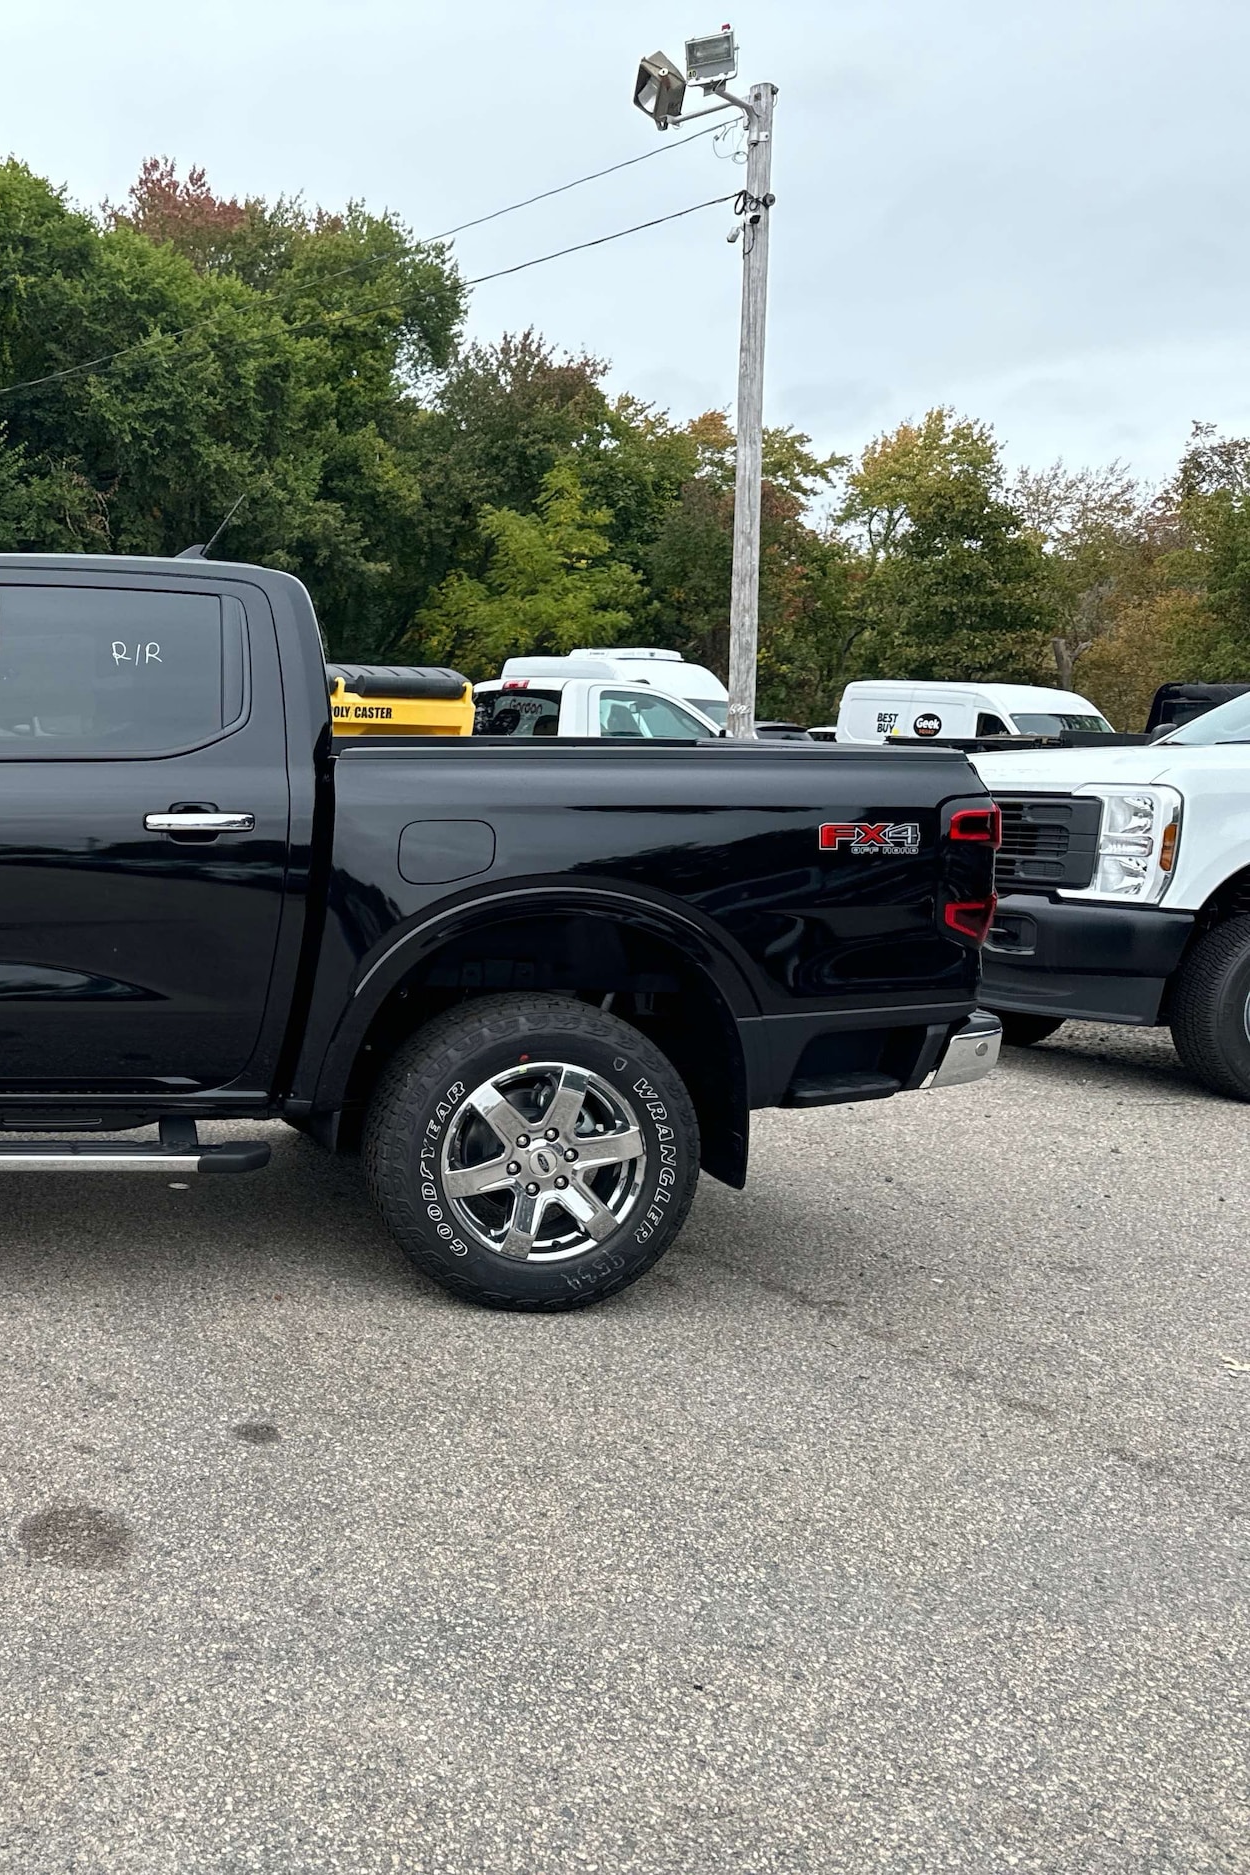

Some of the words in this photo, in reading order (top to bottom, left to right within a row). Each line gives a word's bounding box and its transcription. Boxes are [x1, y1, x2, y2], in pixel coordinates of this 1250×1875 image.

[112, 641, 163, 666] R/R
[332, 706, 351, 718] OLY
[354, 706, 393, 719] CASTER
[877, 712, 899, 724] BEST
[877, 723, 895, 734] BUY
[916, 717, 940, 730] Geek
[819, 823, 921, 851] FX4
[851, 846, 879, 855] OFF
[882, 846, 919, 855] ROAD
[633, 1077, 678, 1245] WRANGLER
[420, 1080, 468, 1257] GOODYEAR
